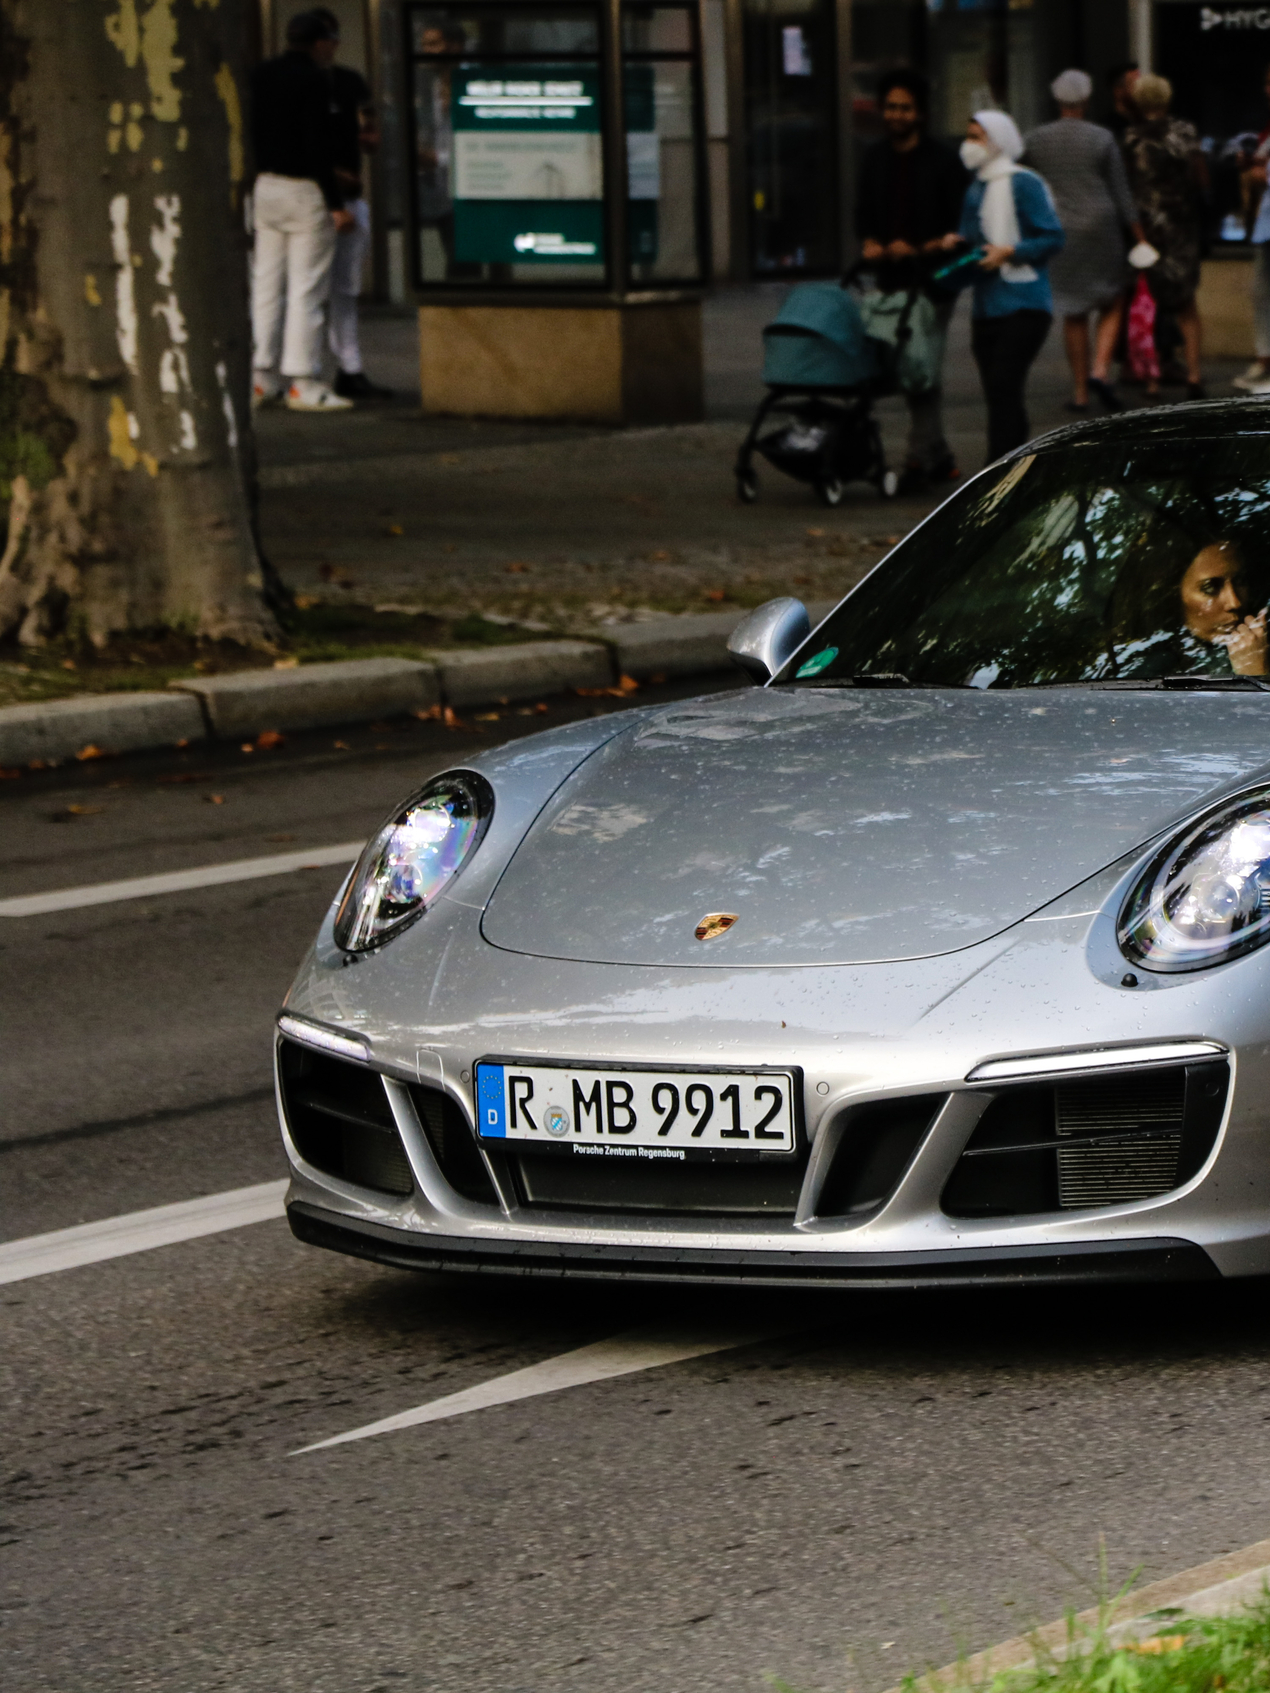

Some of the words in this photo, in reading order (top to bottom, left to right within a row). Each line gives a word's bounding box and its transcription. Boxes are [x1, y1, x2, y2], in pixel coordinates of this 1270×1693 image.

[507, 1075, 539, 1131] R
[572, 1078, 638, 1135] MB
[651, 1082, 786, 1140] 9912
[487, 1109, 498, 1125] D
[573, 1144, 604, 1156] Porsche
[604, 1145, 638, 1157] Zentrum
[638, 1146, 686, 1160] Regensburg
